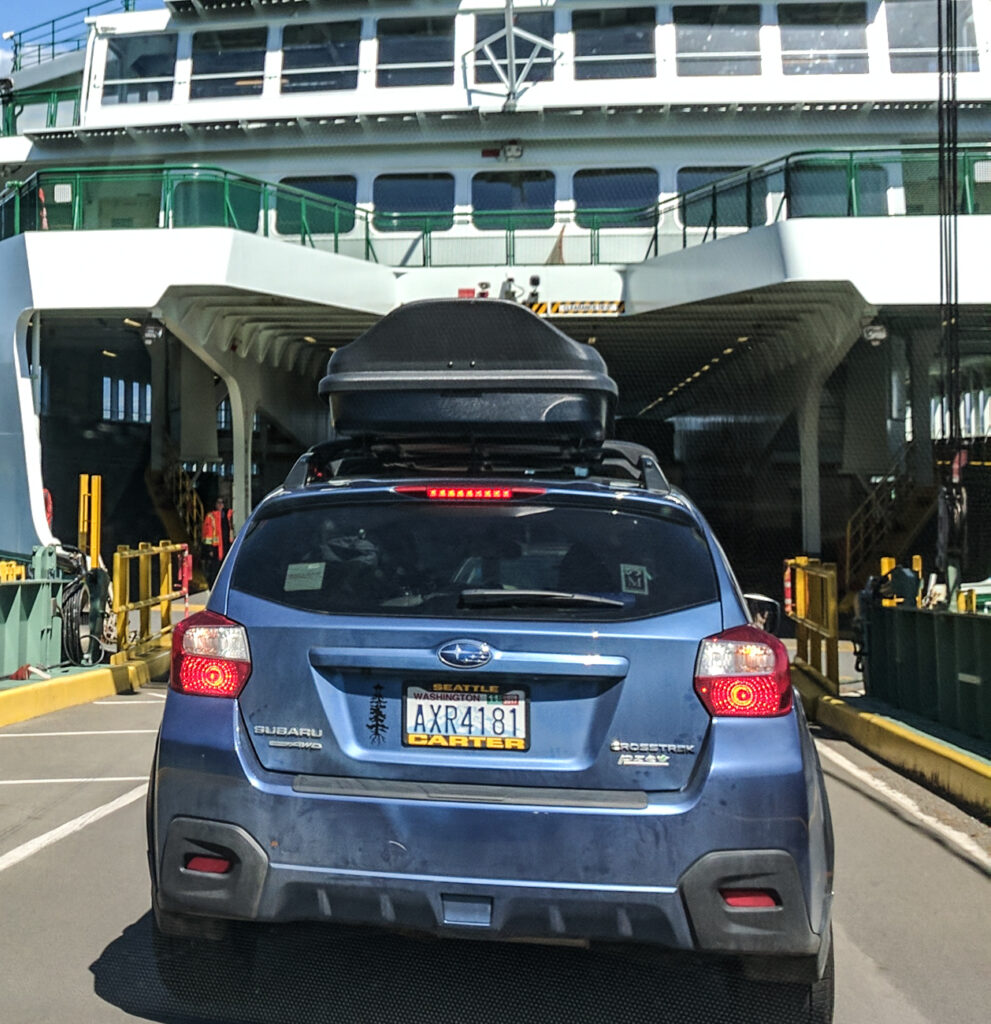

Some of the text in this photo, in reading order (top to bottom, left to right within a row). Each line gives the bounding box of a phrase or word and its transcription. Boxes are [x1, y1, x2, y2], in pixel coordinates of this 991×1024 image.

[432, 683, 499, 693] SEATTLE
[413, 692, 481, 702] WASHINGTON
[413, 704, 517, 737] AXR4181
[253, 725, 323, 738] SUBARU
[408, 733, 525, 750] CARTER
[610, 741, 695, 753] CROSSTREK
